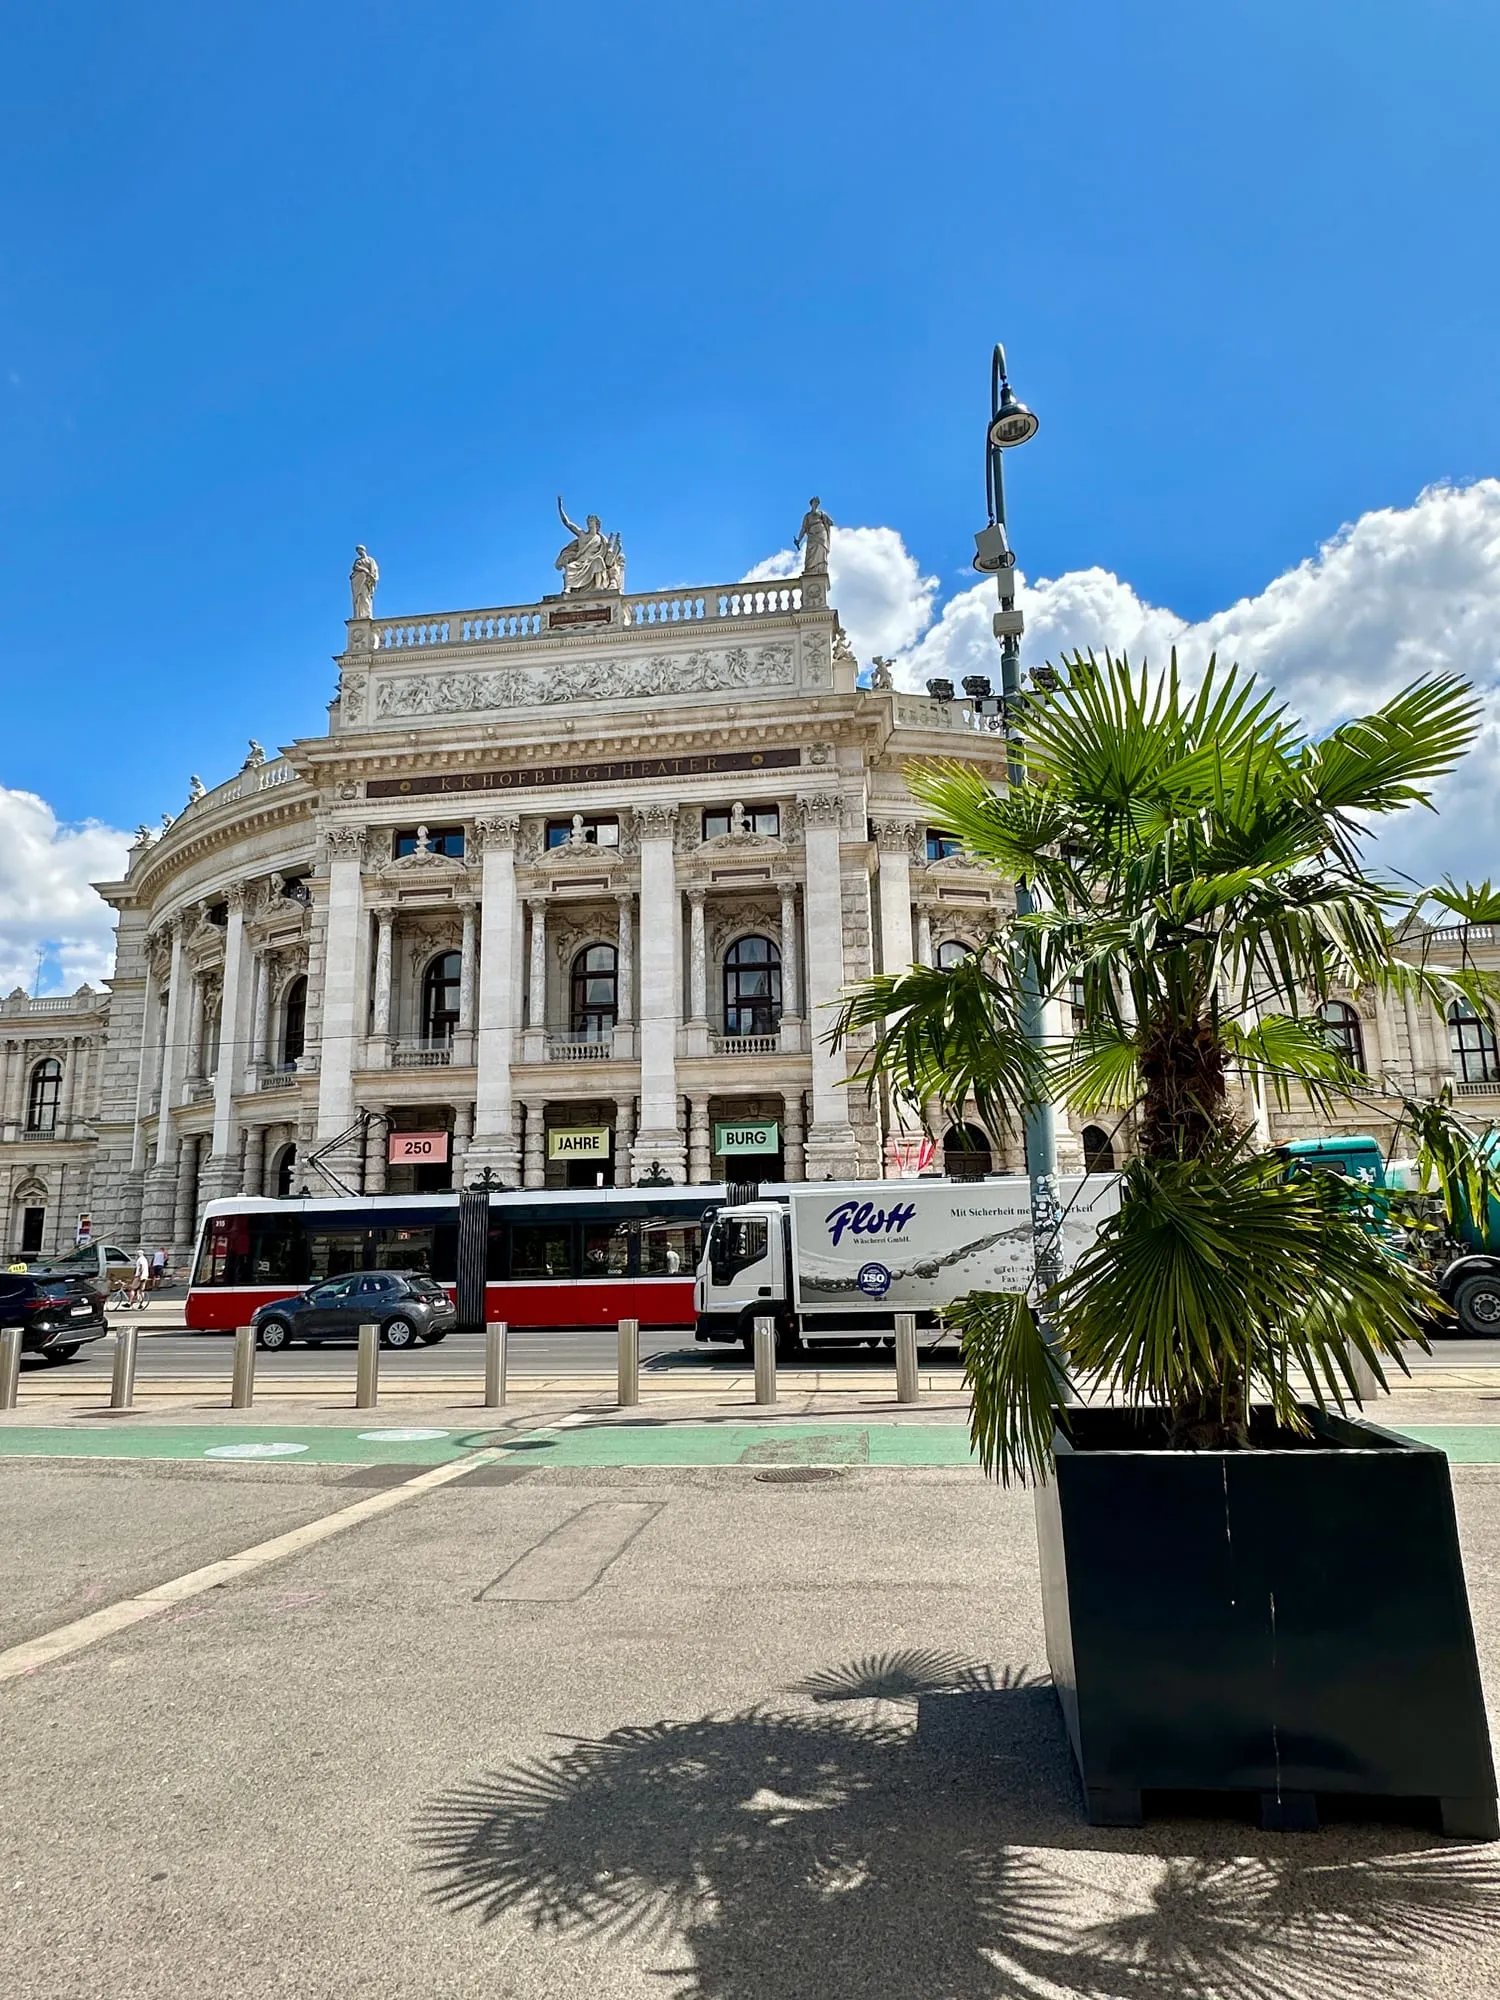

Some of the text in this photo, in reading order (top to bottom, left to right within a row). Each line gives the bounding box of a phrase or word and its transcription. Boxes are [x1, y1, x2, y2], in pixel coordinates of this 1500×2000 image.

[441, 757, 718, 790] K K HOFBURGTHEATER
[558, 1136, 600, 1150] JAHRE
[726, 1131, 767, 1145] BURG
[404, 1141, 432, 1155] 250
[951, 1208, 966, 1217] Mit
[969, 1206, 1014, 1216] Sicherheit
[825, 1200, 917, 1247] Flott
[863, 1273, 885, 1283] ISO
